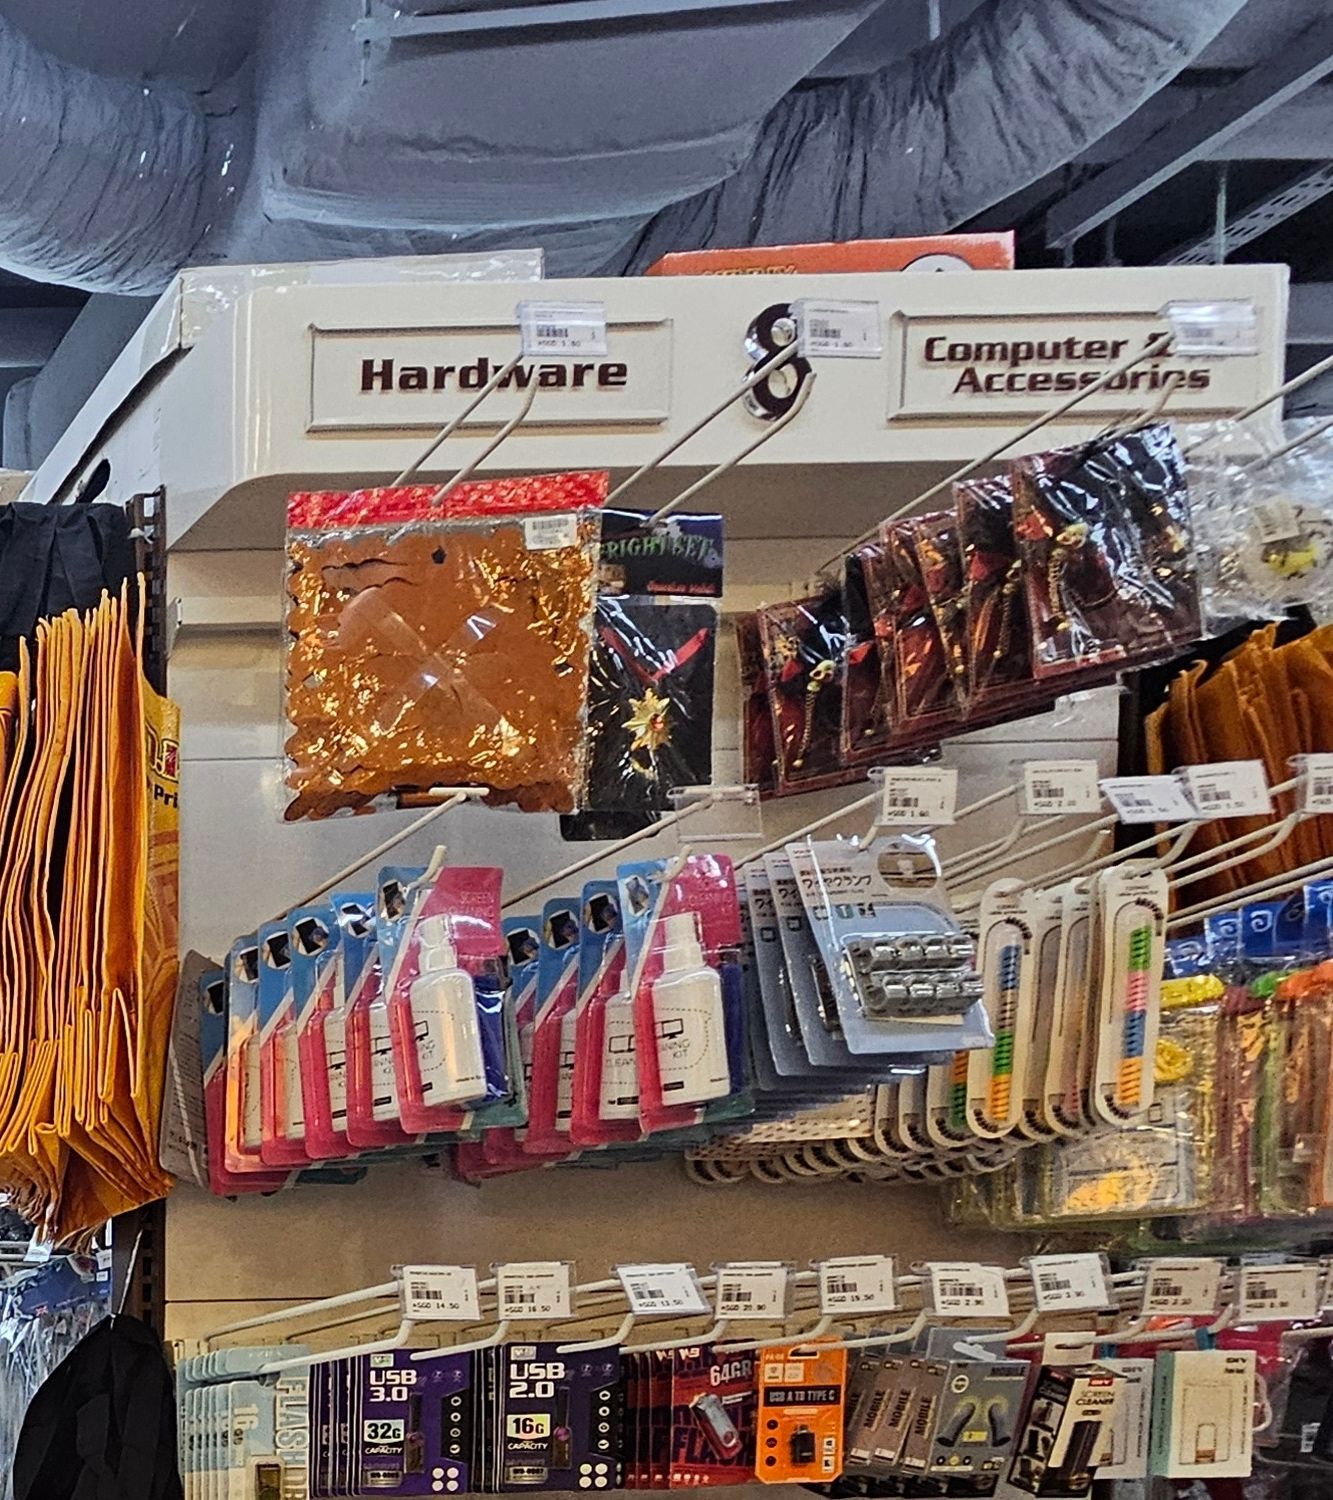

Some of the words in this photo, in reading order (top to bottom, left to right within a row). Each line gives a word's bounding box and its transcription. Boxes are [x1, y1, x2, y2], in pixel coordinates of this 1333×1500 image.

[743, 302, 813, 421] 8
[923, 335, 1117, 369] Computer
[360, 356, 628, 393] Hardware
[952, 366, 1211, 394] Accessories
[369, 1369, 418, 1386] USB
[509, 1362, 566, 1381] USB
[990, 1366, 1027, 1377] MOBILE
[368, 1386, 409, 1402] 3.0
[508, 1381, 556, 1399] 2.0
[768, 1389, 785, 1404] USB
[785, 1389, 794, 1403] A
[795, 1389, 806, 1403] TO
[806, 1388, 827, 1403] TYPE
[233, 1403, 259, 1430] 16
[863, 1389, 887, 1429] MOBILE
[888, 1387, 912, 1429] MOBILE
[914, 1395, 933, 1435] MOBILE
[275, 1376, 309, 1467] FLASH
[366, 1422, 402, 1441] 32G
[511, 1417, 546, 1437] 16G
[364, 1445, 403, 1455] CAPACITY
[507, 1441, 549, 1451] CAPACITY
